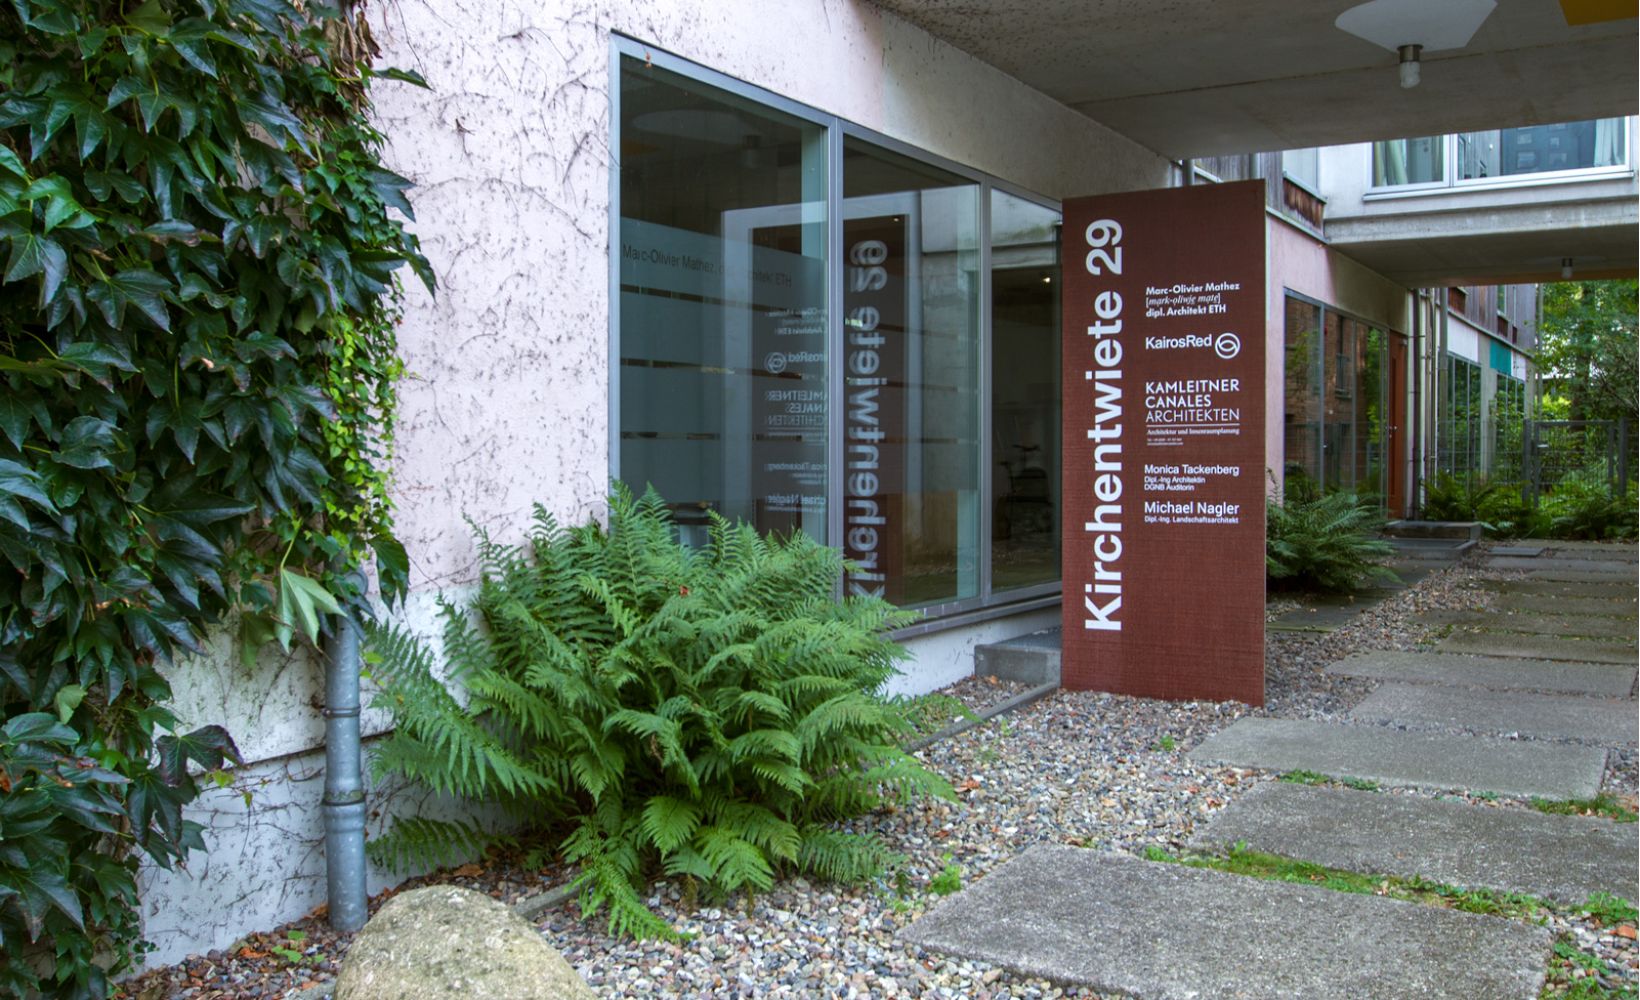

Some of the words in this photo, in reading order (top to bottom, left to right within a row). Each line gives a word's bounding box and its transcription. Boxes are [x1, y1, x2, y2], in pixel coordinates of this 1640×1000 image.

[1084, 218, 1123, 275] 29
[623, 243, 681, 266] Marc-Olivier
[1145, 284, 1203, 295] Marc-Olivier
[1205, 281, 1240, 292] Mathez
[1145, 308, 1165, 318] dipl.
[1166, 306, 1207, 317] Architekt
[1208, 304, 1226, 314] ETH
[1145, 334, 1212, 350] KairosRed
[1145, 379, 1240, 394] KAMLEITNER
[1145, 394, 1212, 408] CANALES
[1145, 408, 1240, 423] ARCHITEKTEN
[1084, 291, 1123, 631] Kirchentwiete
[1144, 464, 1179, 474] Monica
[1182, 464, 1240, 477] Tackenberg
[1166, 483, 1195, 491] Auditorin
[1172, 476, 1206, 484] Architektin
[1144, 501, 1193, 514] Michael
[1197, 502, 1240, 516] Nagler
[1144, 515, 1171, 524] Dipl.-Ing.
[1172, 516, 1239, 524] Landschaftsarchitekt
